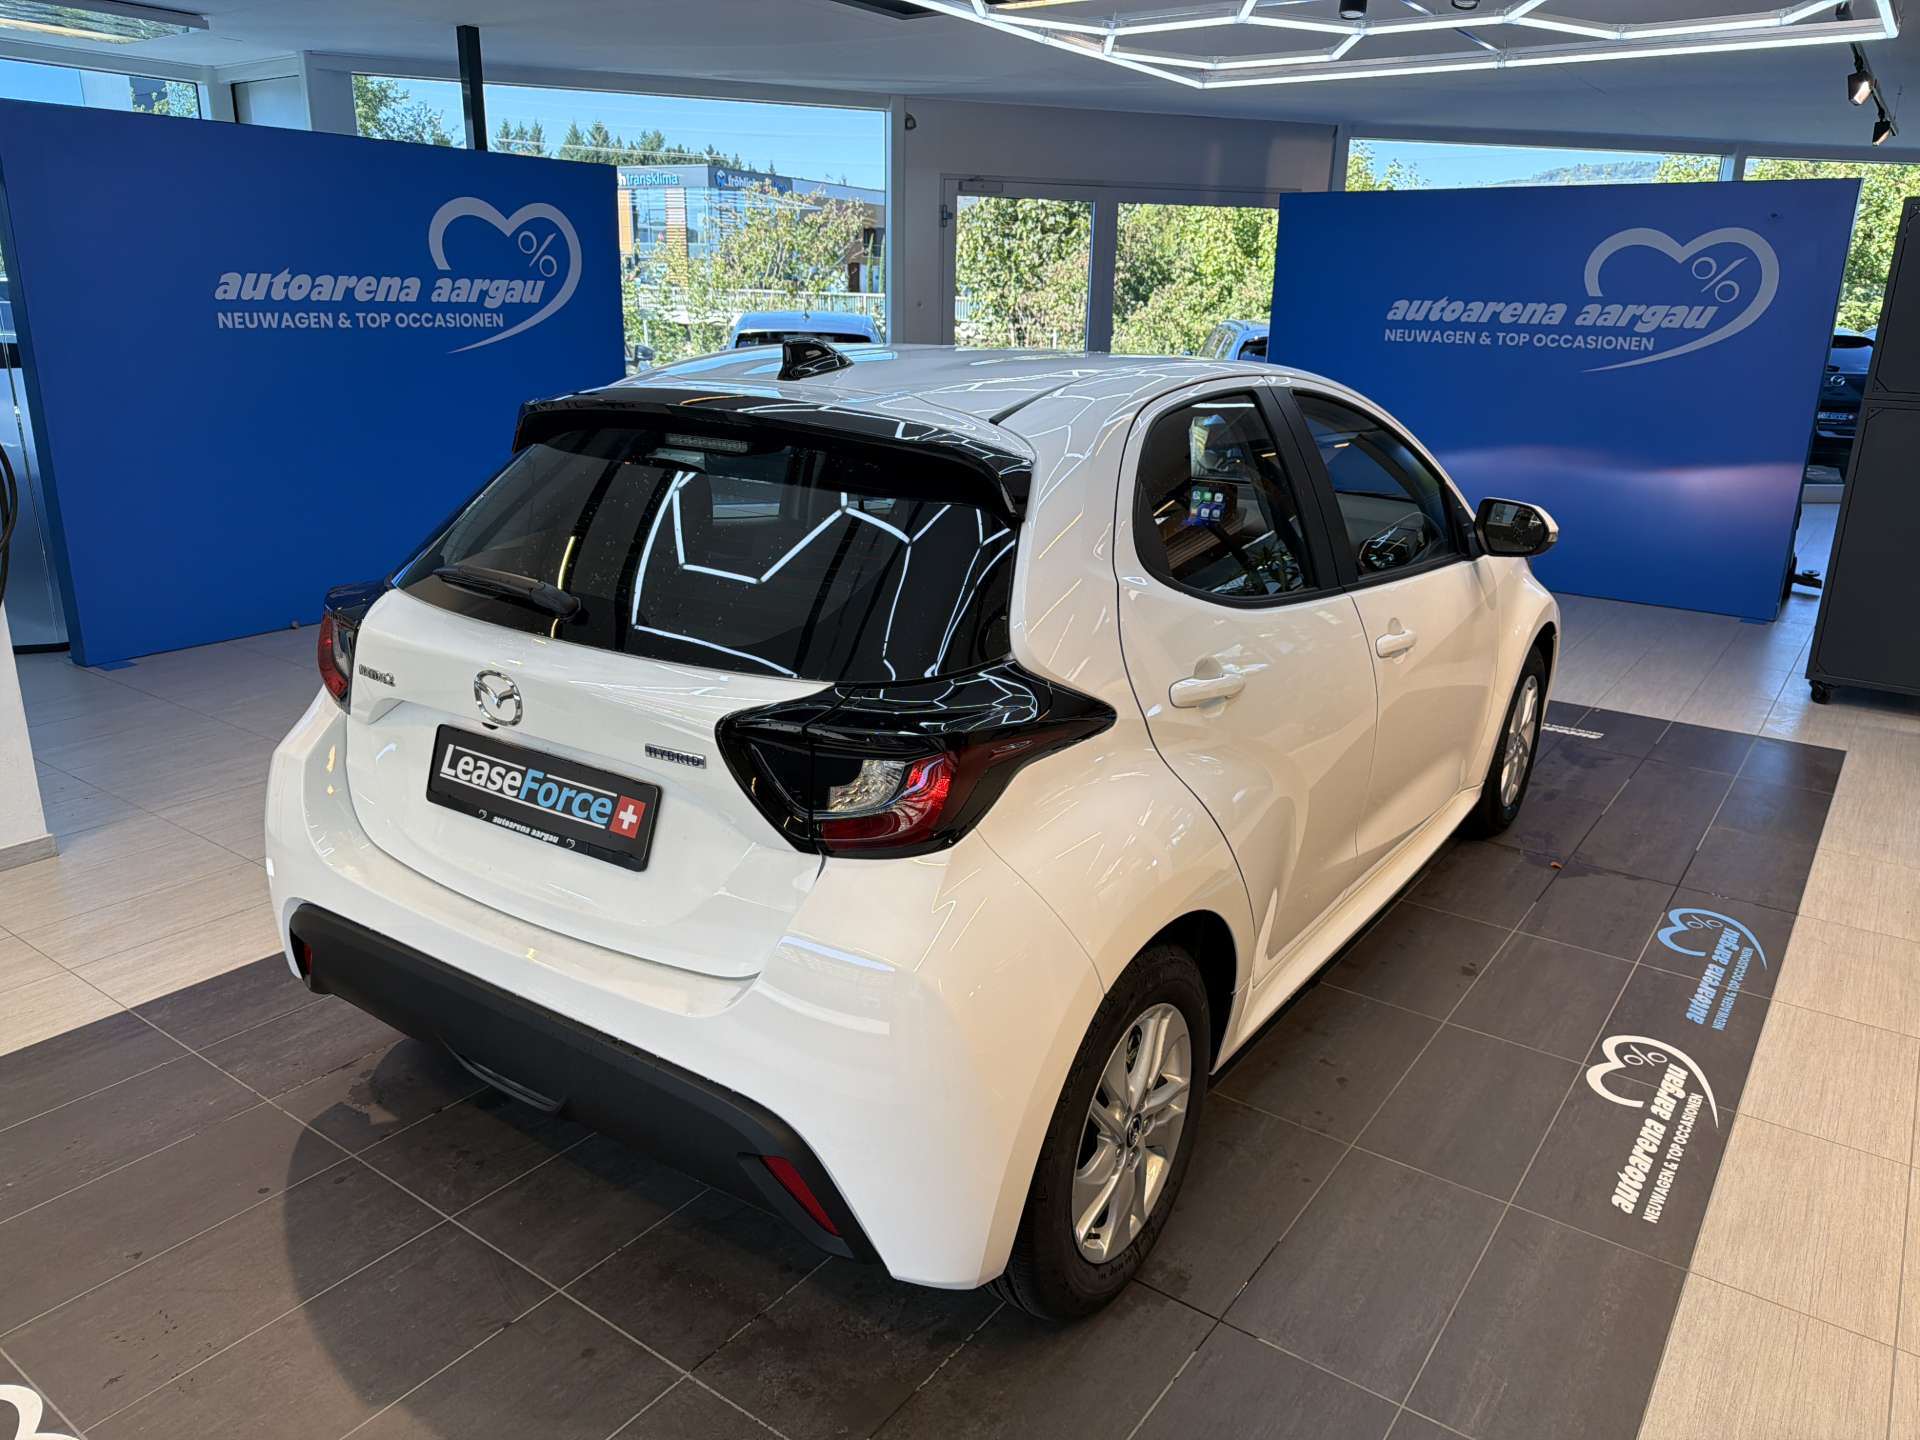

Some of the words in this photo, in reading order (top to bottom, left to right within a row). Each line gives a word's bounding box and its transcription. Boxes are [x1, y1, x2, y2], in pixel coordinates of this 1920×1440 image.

[214, 266, 421, 302] autoarena
[431, 276, 546, 309] aargau
[217, 311, 334, 329] NEUWAGEN
[338, 312, 353, 329] &
[355, 312, 391, 329] TOP
[398, 312, 504, 328] OCCASIONEN
[1386, 294, 1568, 326] autoarena
[1574, 303, 1719, 333] aargau
[1384, 328, 1476, 345] NEUWAGEN
[1480, 331, 1492, 346] &
[1497, 332, 1530, 347] TOP
[1533, 333, 1655, 351] OCCASIONEN
[440, 743, 613, 825] LeaseForce
[492, 816, 531, 834] autoarena
[530, 828, 560, 844] aargau
[1685, 963, 1727, 1025] autoarena
[1711, 927, 1741, 966] aargau
[1731, 947, 1754, 980] OCCASIONEN
[1727, 979, 1741, 991] TOP
[1711, 997, 1737, 1031] NEUWAGEN
[1673, 1092, 1704, 1145] OCCASIONEN
[1611, 1118, 1666, 1215] autoarena
[1650, 1063, 1689, 1121] aargau
[1666, 1138, 1685, 1162] TOP
[1663, 1160, 1679, 1171] &
[1642, 1168, 1676, 1224] NEUWAGEN
